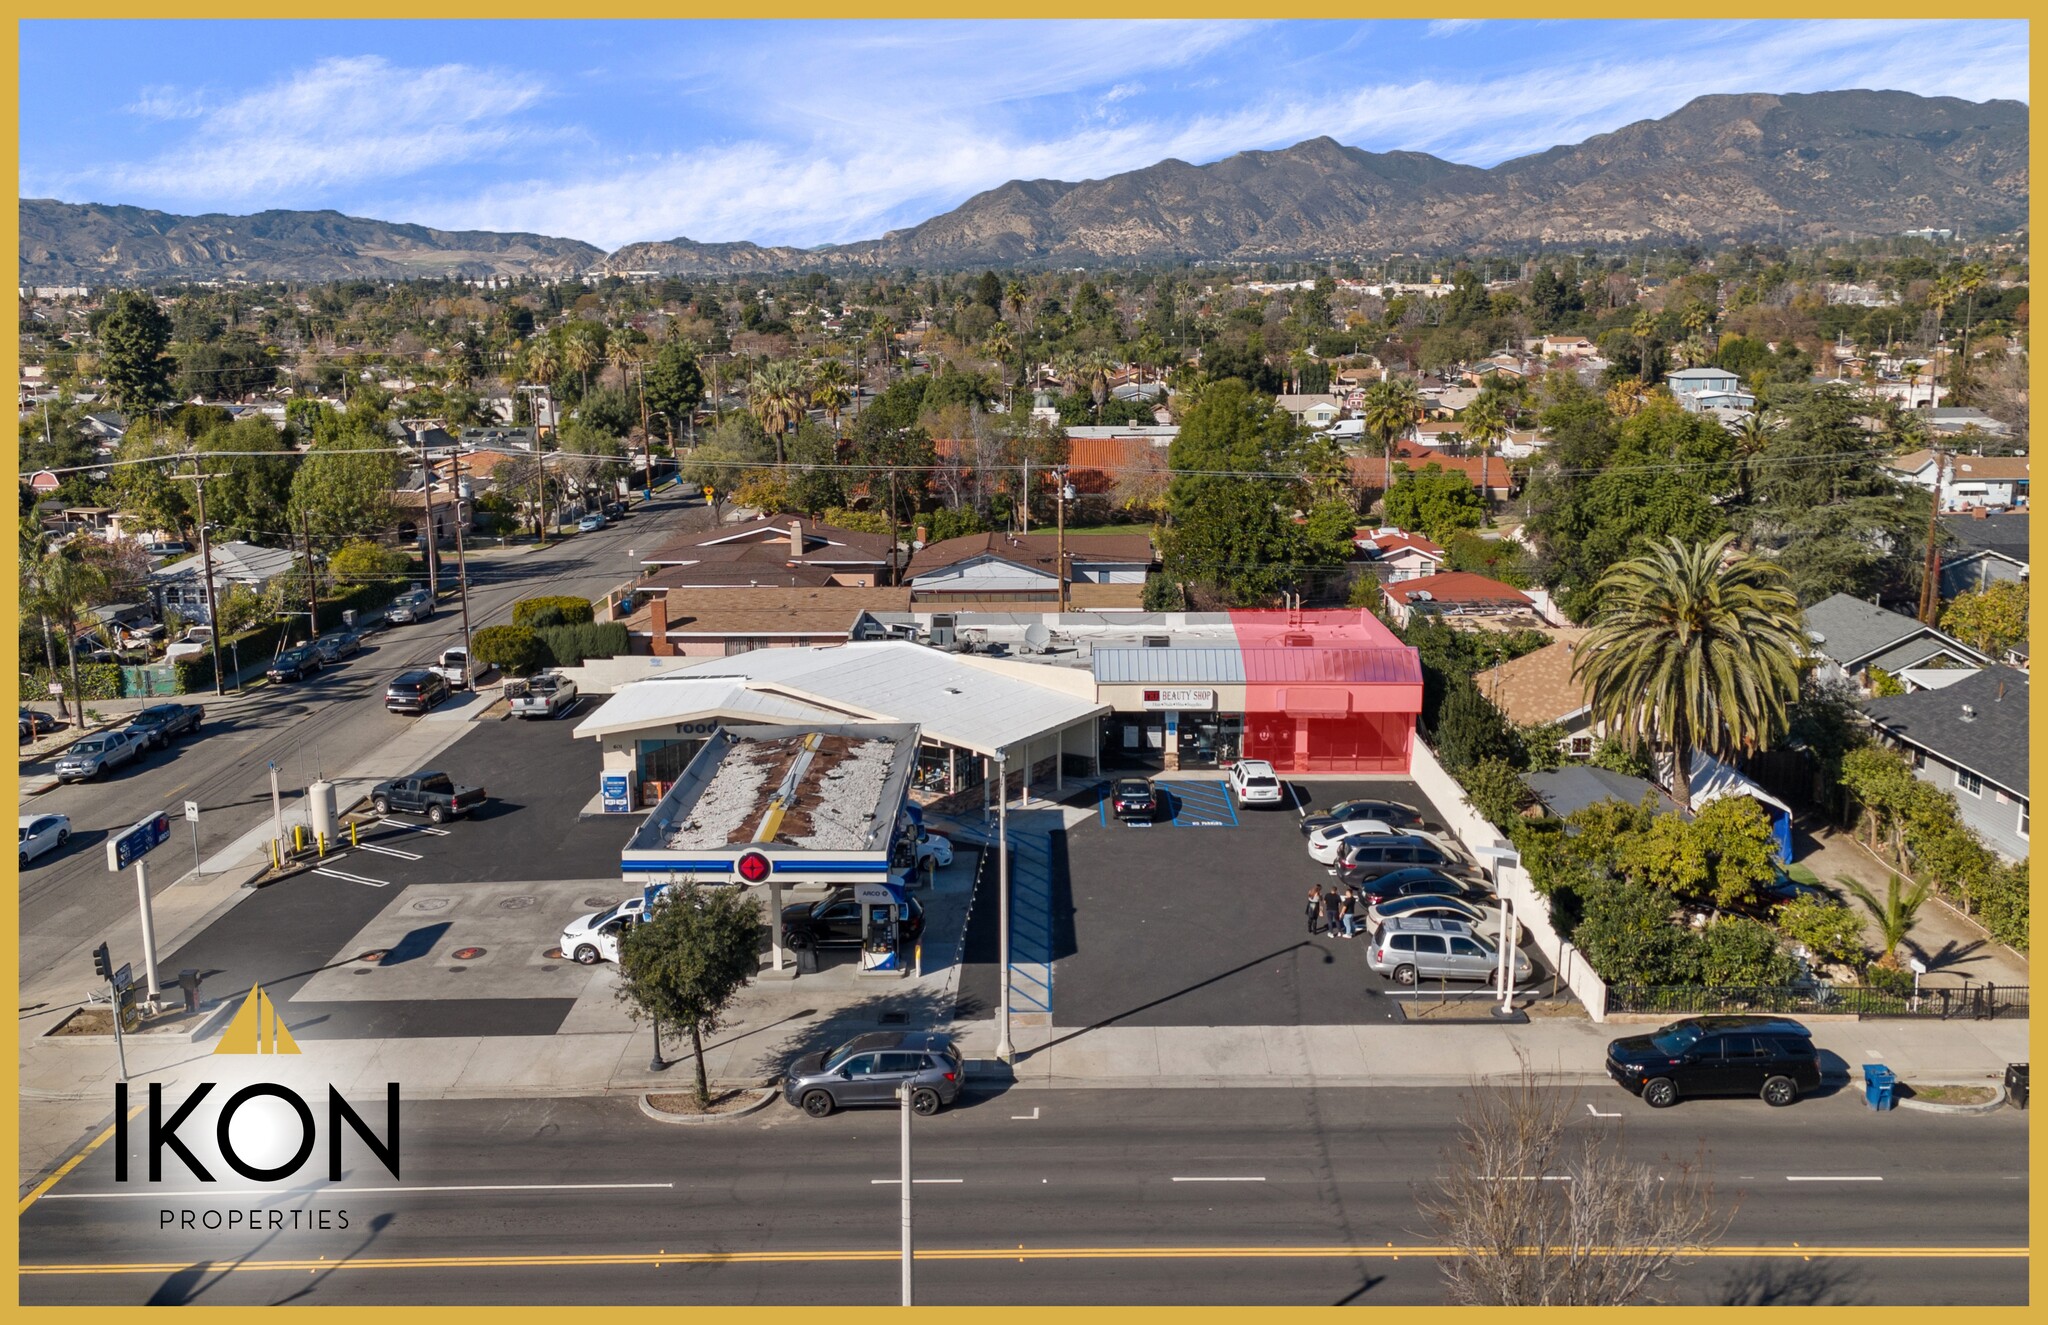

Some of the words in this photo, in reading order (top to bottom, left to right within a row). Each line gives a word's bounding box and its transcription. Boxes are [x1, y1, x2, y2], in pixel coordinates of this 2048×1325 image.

[1162, 690, 1191, 700] BEAUTY
[1193, 691, 1211, 700] SHOP
[675, 720, 719, 734] food
